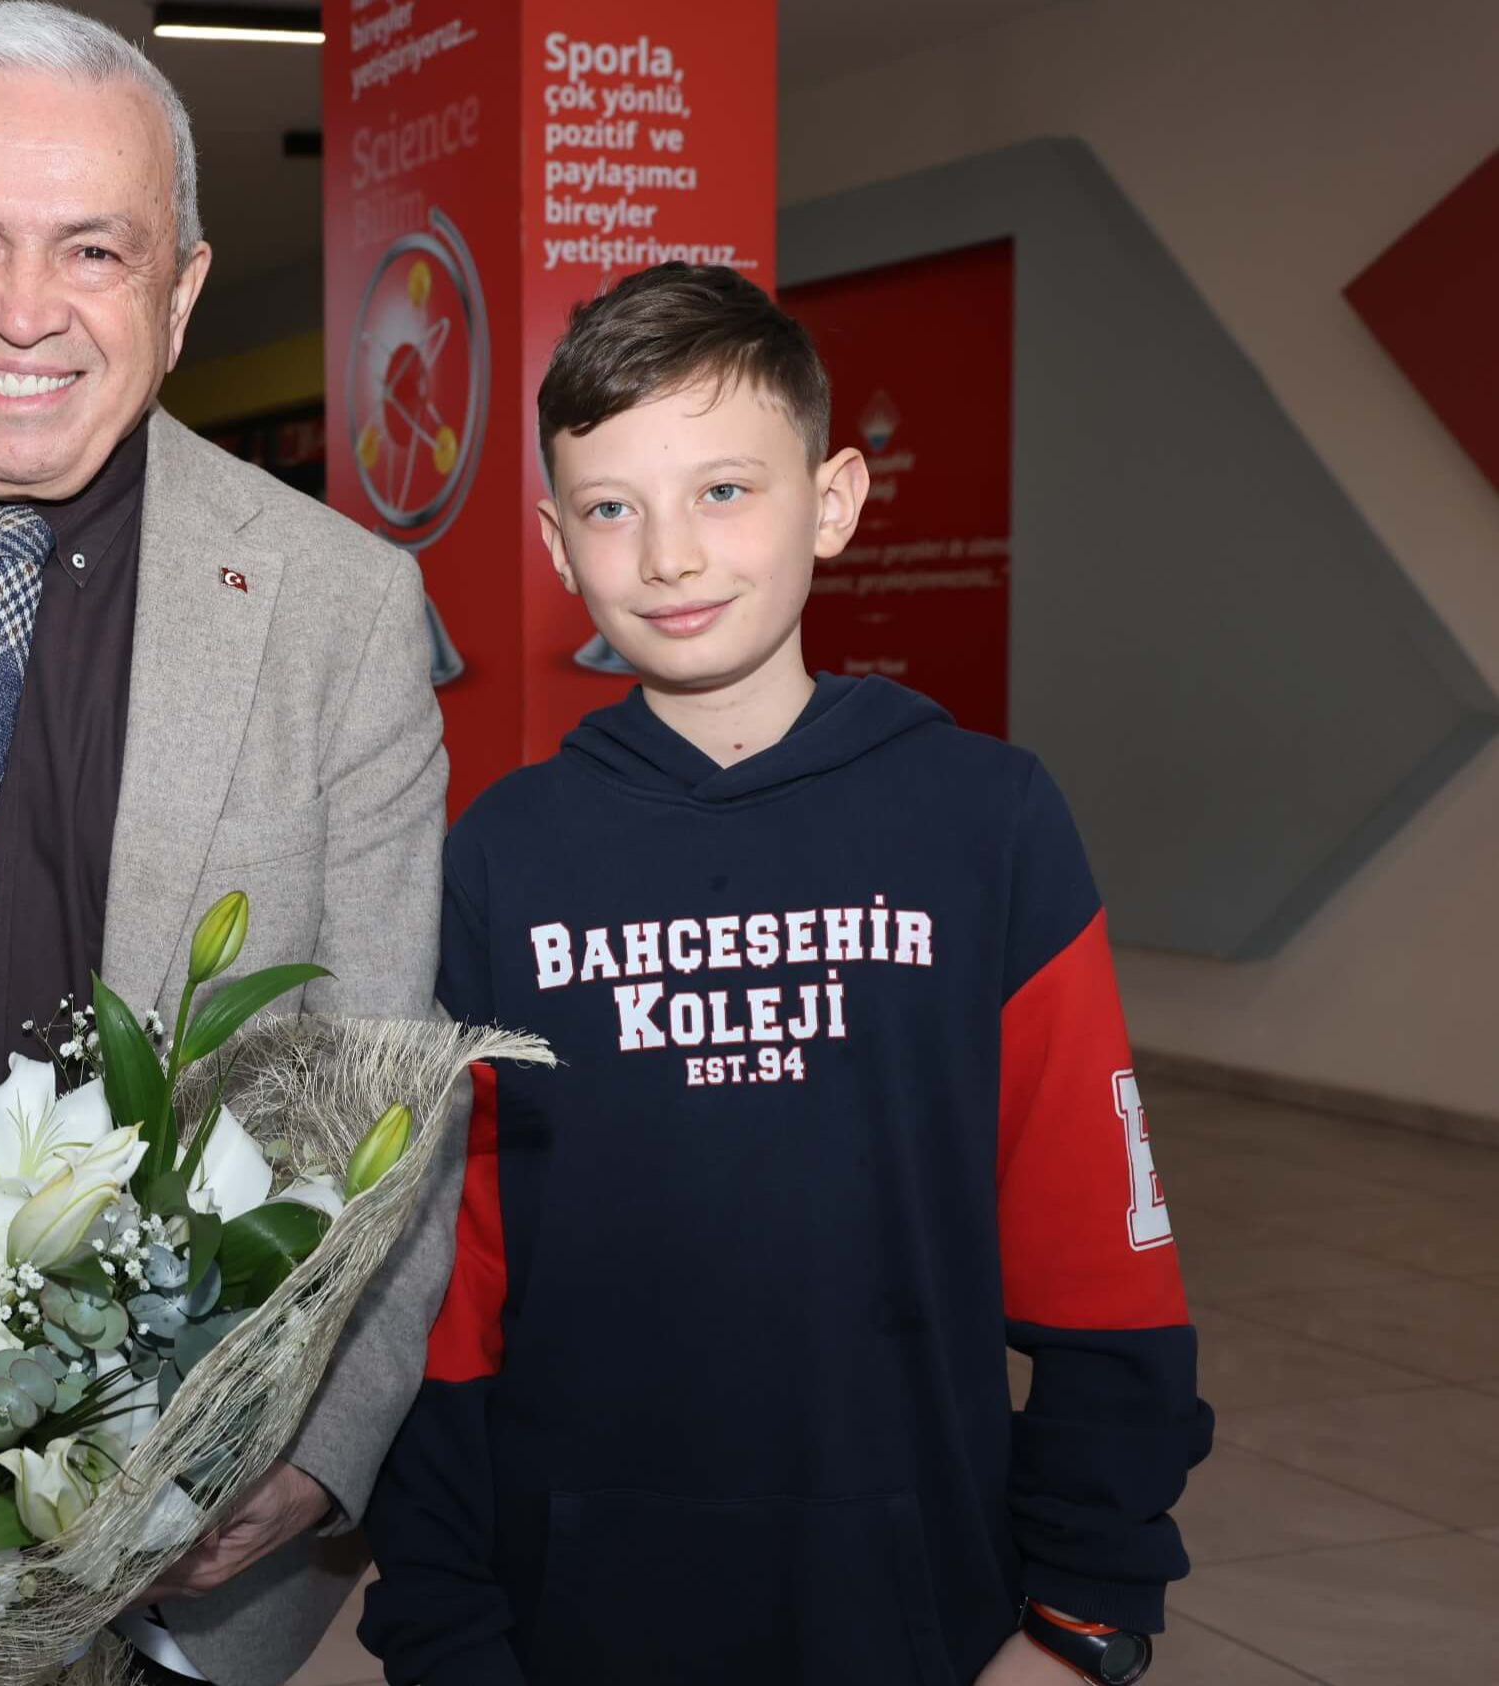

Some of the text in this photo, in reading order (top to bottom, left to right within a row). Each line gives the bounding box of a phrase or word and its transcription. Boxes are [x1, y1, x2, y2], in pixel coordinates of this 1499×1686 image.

[544, 33, 684, 82] Sporla,
[544, 82, 691, 119] çok yönlü,
[351, 95, 480, 190] Science
[545, 120, 684, 153] pozitif ve
[545, 158, 697, 194] paylaşımcı
[545, 196, 658, 233] bireyler
[530, 894, 933, 990] BAHÇEŞEHİR
[613, 968, 847, 1052] KOLEJİ
[686, 1047, 805, 1086] EST.94
